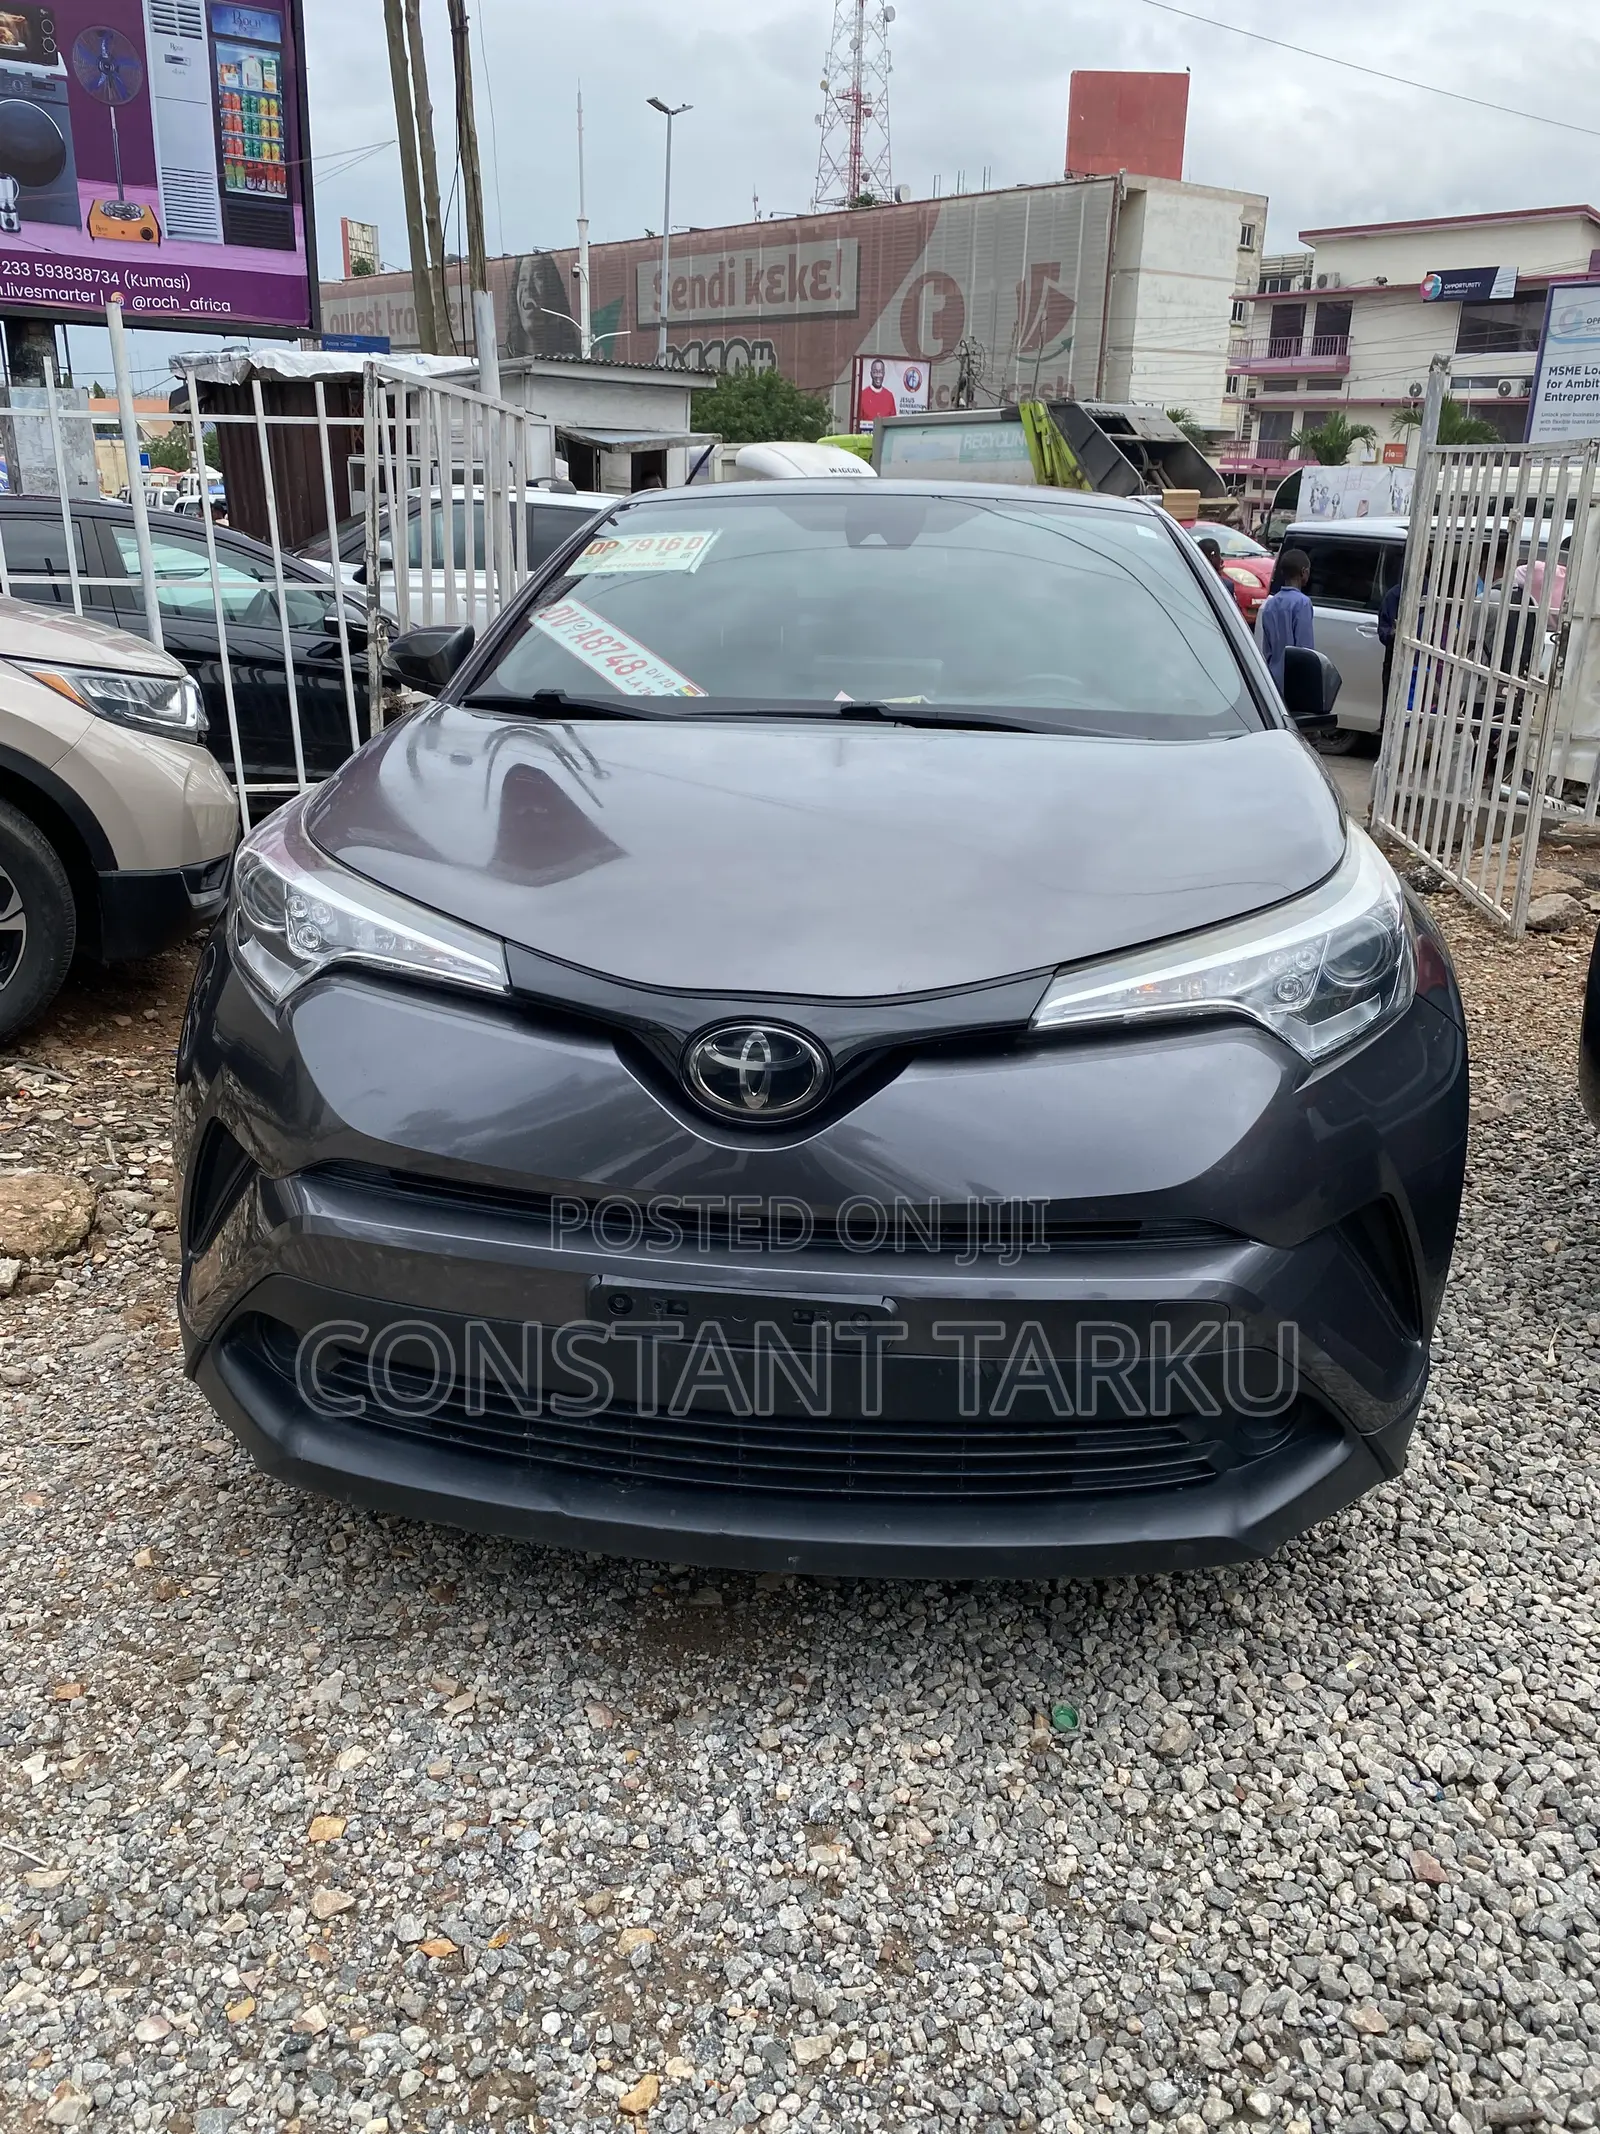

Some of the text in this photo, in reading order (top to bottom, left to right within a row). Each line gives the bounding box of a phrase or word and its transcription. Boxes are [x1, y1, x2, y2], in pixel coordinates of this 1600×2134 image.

[1, 260, 191, 292] 233 593838734 (Kumasi)
[653, 257, 736, 312] Sendi
[132, 295, 231, 312] @roch_africa
[329, 301, 383, 336] owest
[1548, 366, 1582, 376] MSME
[1546, 378, 1600, 389] for Ambit
[1544, 392, 1599, 403] Entrepren
[964, 431, 1028, 449] RECYCLIN
[584, 536, 704, 556] DP 7916 D
